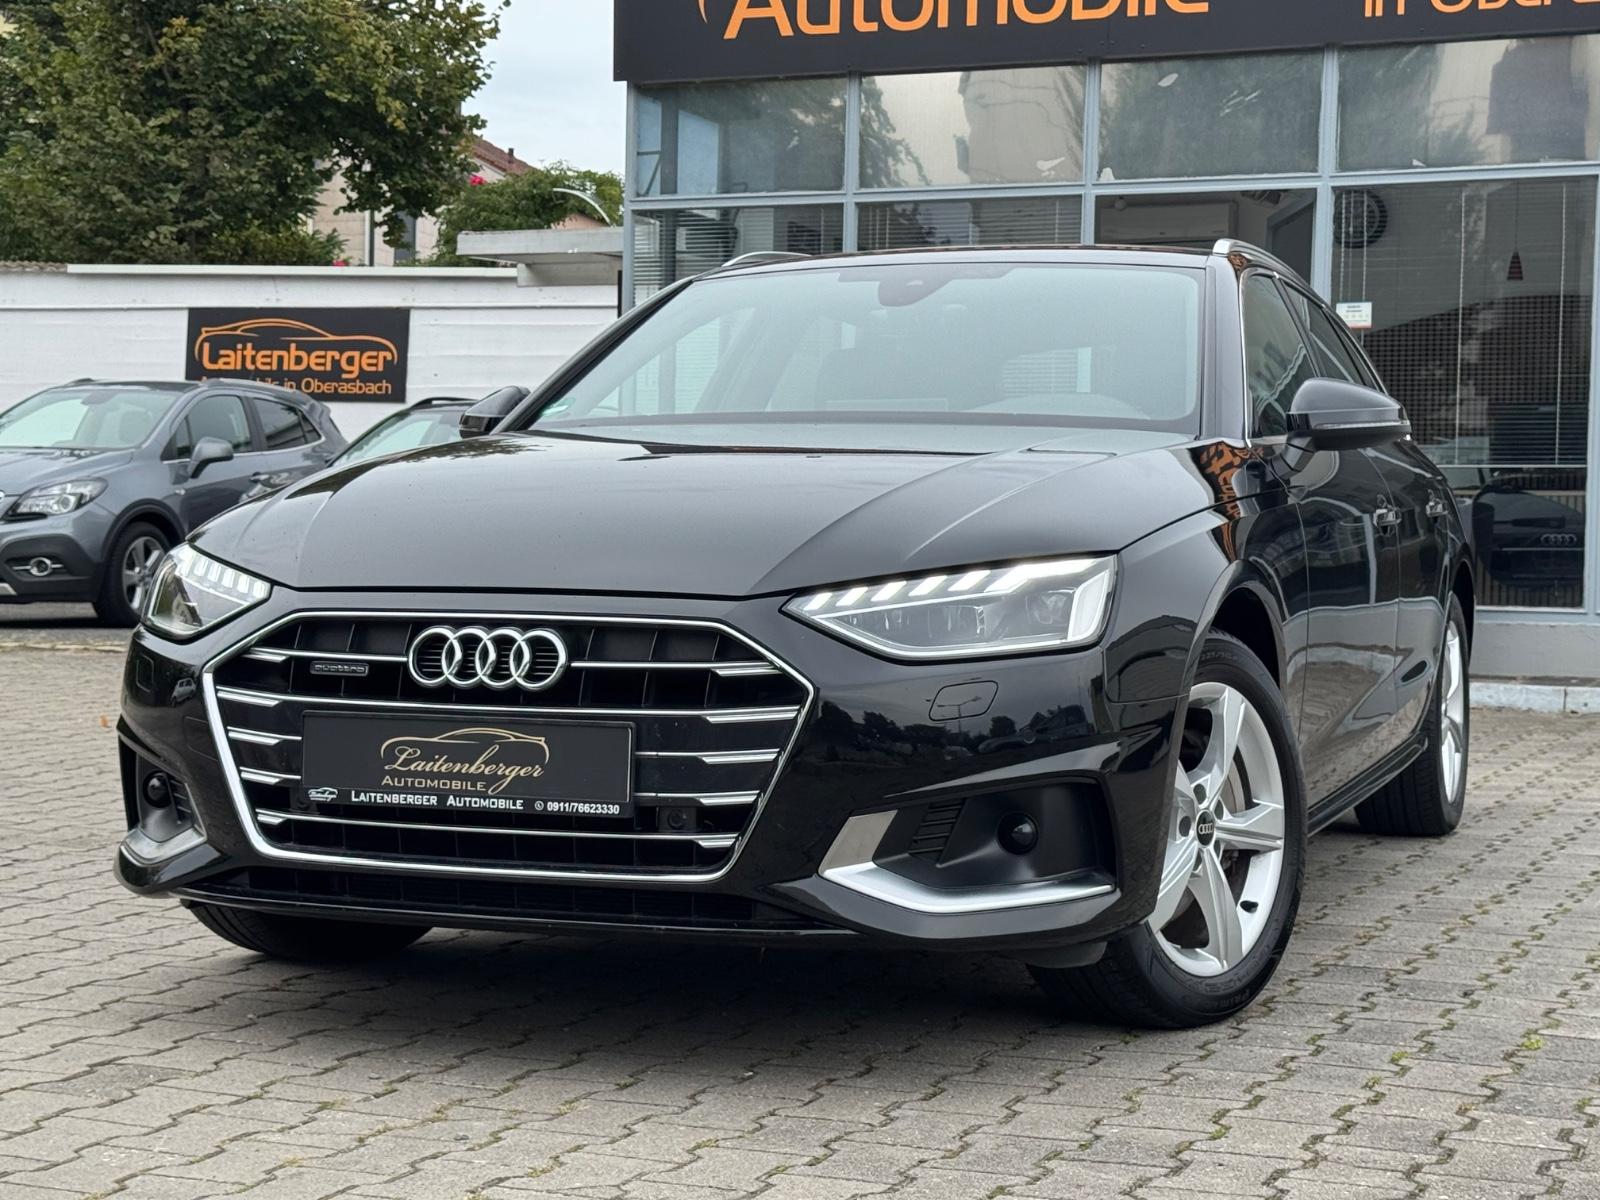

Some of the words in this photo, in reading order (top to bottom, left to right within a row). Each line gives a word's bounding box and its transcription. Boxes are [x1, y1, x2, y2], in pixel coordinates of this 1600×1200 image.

[723, 0, 1209, 39] Autom
[202, 342, 393, 379] Laitenberger
[301, 377, 392, 394] Oberasbach
[381, 775, 487, 791] AUTOMOBILE
[384, 744, 544, 795] Laitenberger
[351, 790, 438, 806] LAITENBERGER
[446, 795, 524, 810] AUTOMOBILE
[547, 801, 620, 815] 0911/76623330
